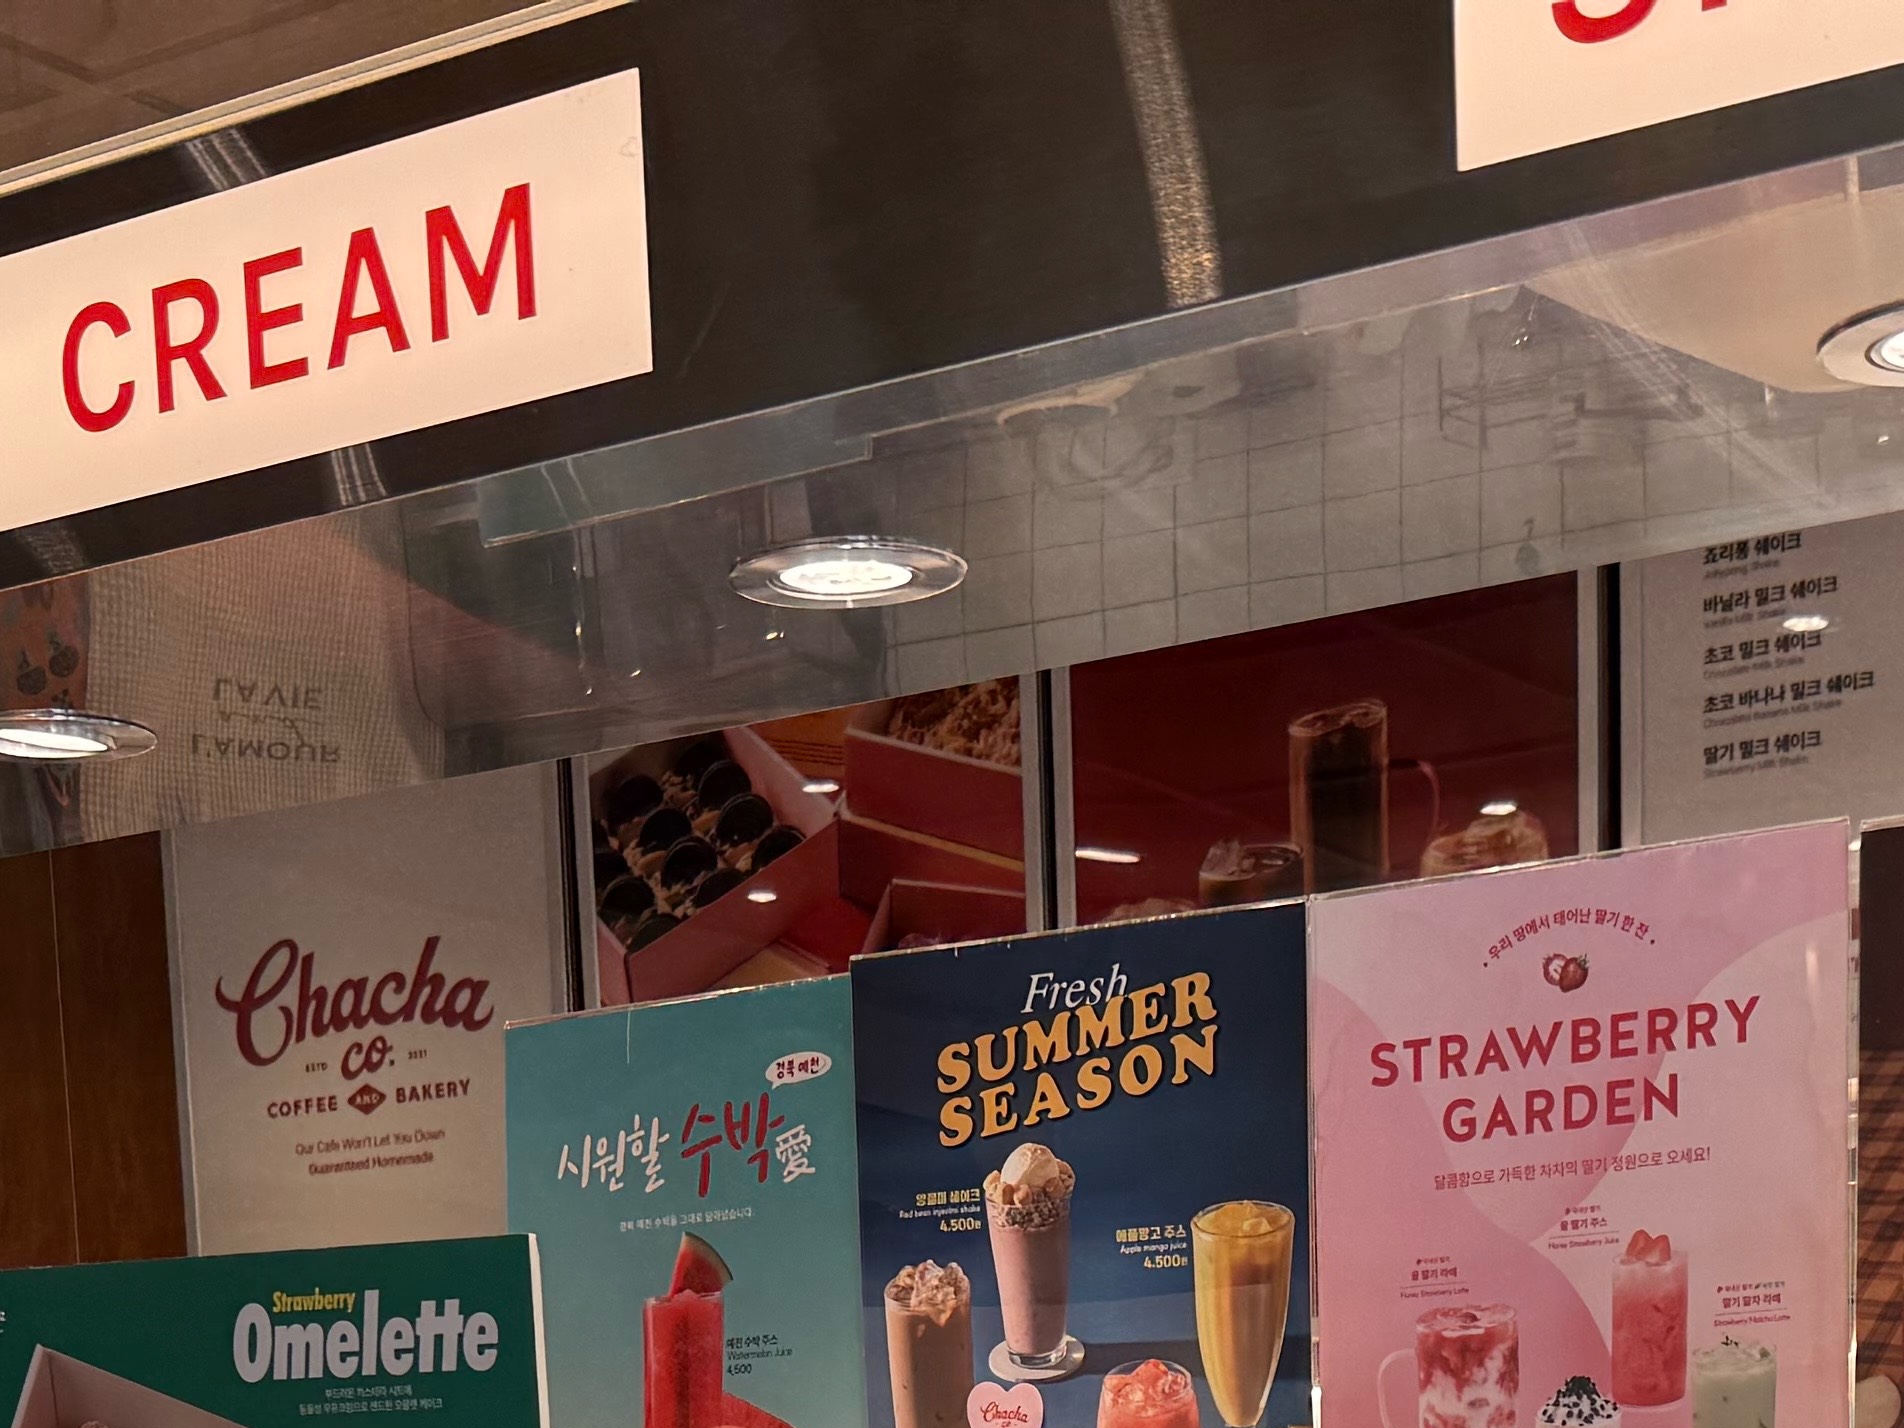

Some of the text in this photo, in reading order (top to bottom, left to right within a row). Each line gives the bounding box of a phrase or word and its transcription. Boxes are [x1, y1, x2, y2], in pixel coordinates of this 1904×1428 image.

[61, 182, 540, 436] CREAM
[215, 935, 494, 1067] Chacha
[937, 971, 1218, 1094] SUMMER
[1021, 963, 1129, 1013] Fresh
[939, 1025, 1218, 1147] SEASON
[1370, 995, 1760, 1087] STRAWBERRY
[267, 1095, 338, 1118] COFFEE
[396, 1078, 471, 1104] BAKERY
[1442, 1073, 1679, 1143] GARDEN
[558, 1115, 670, 1193] 시원할
[233, 1289, 498, 1383] Omelette
[272, 1287, 356, 1313] Strawberry
